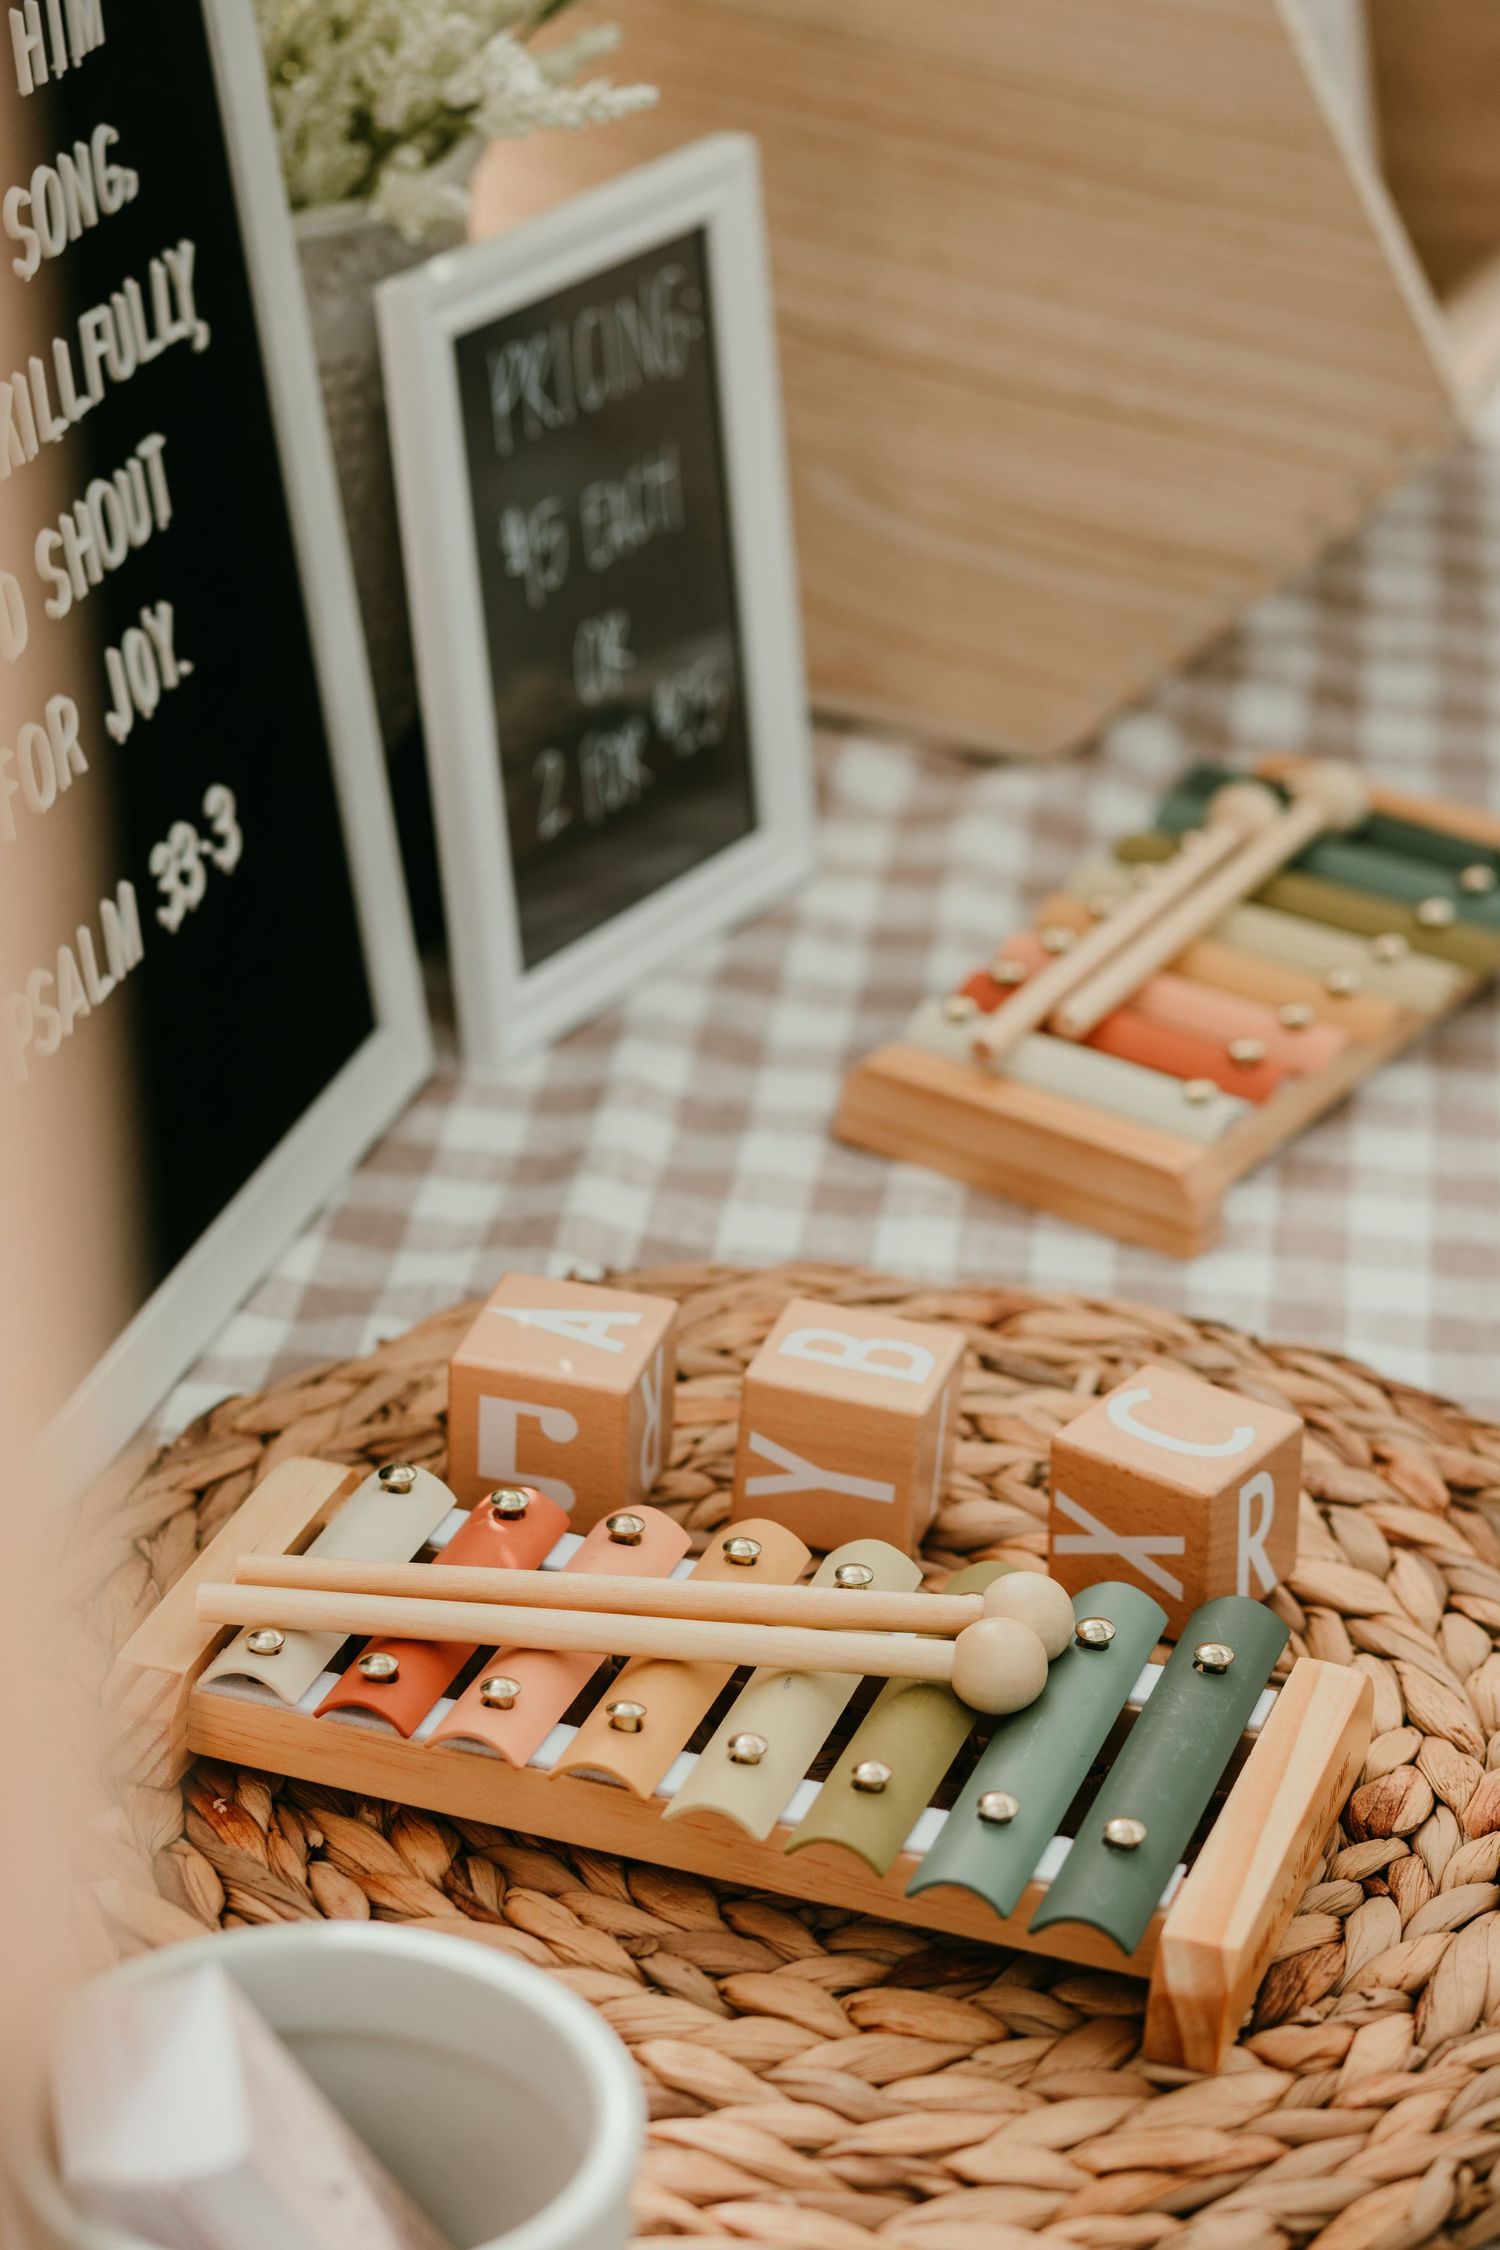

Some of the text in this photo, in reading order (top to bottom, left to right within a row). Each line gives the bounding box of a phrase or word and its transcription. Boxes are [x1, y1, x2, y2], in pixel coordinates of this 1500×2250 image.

[8, 0, 106, 97] HIM
[35, 432, 172, 620] SHOUT
[579, 440, 686, 573] EACH
[104, 600, 194, 745] JOY.
[573, 609, 635, 705] OR
[533, 747, 573, 841] 2
[578, 715, 656, 826] FOR
[0, 879, 145, 1083] PSALM
[486, 1305, 644, 1355] A
[777, 1326, 936, 1384] B
[744, 1430, 896, 1504] Y
[1106, 1387, 1256, 1458] C
[1053, 1488, 1186, 1602] X
[1236, 1470, 1278, 1597] R
